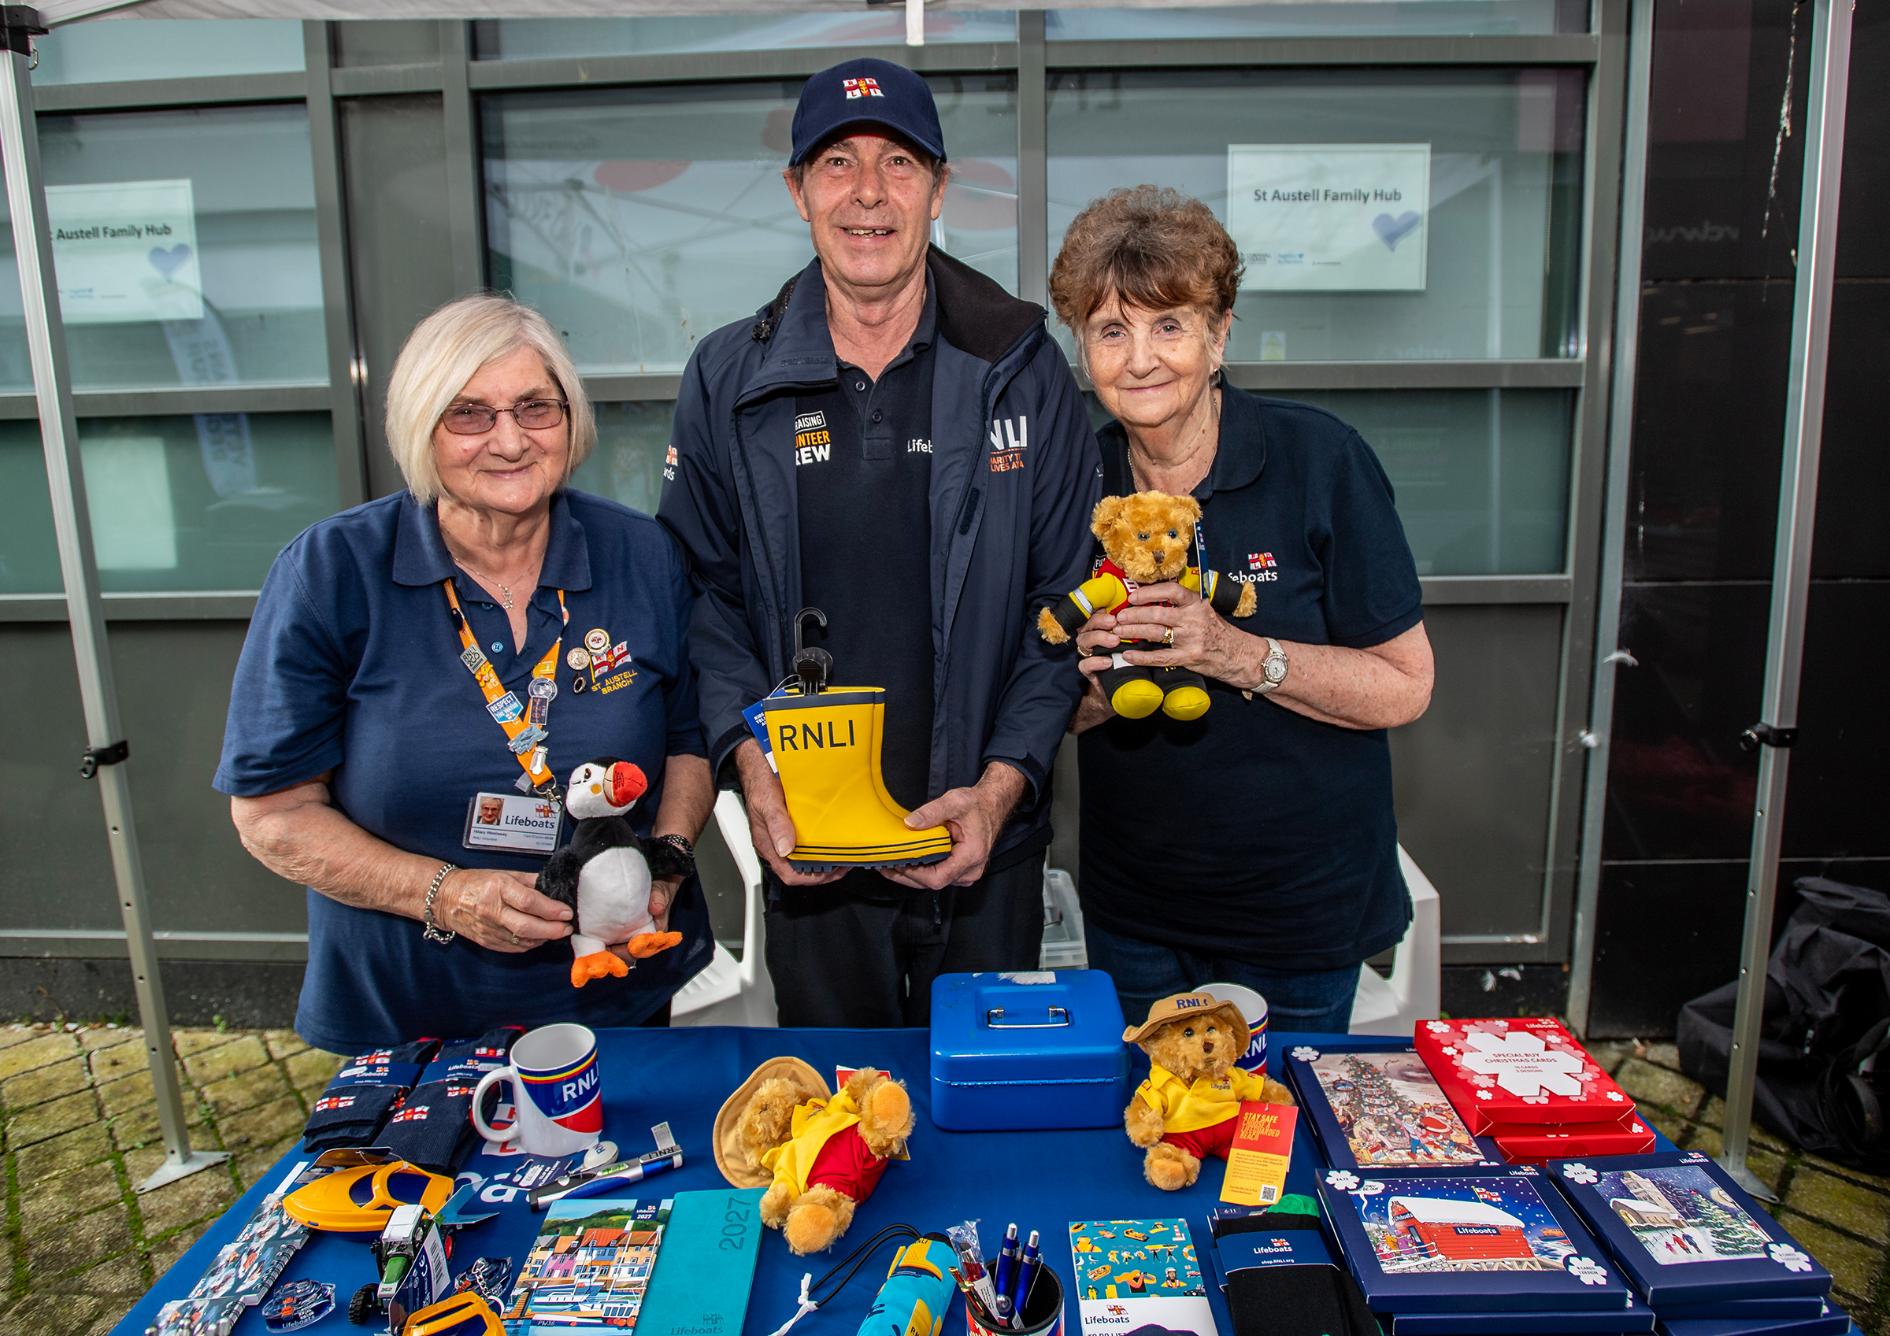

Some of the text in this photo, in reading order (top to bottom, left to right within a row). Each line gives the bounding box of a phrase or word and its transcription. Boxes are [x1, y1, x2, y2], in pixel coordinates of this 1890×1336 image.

[1254, 188, 1402, 204] St Austell Family Hub
[56, 227, 100, 240] Austell
[102, 224, 142, 240] Family
[144, 223, 172, 236] Hub
[601, 678, 633, 695] BRANCH
[779, 720, 855, 752] RNLI
[505, 815, 555, 829] Lifeboats
[719, 1197, 751, 1252] 2027
[1457, 1227, 1498, 1235] Lifeboats
[1253, 1246, 1293, 1254] Lifeboats
[1085, 1316, 1130, 1325] Lifeboats
[670, 1325, 724, 1336] Lifeboats
